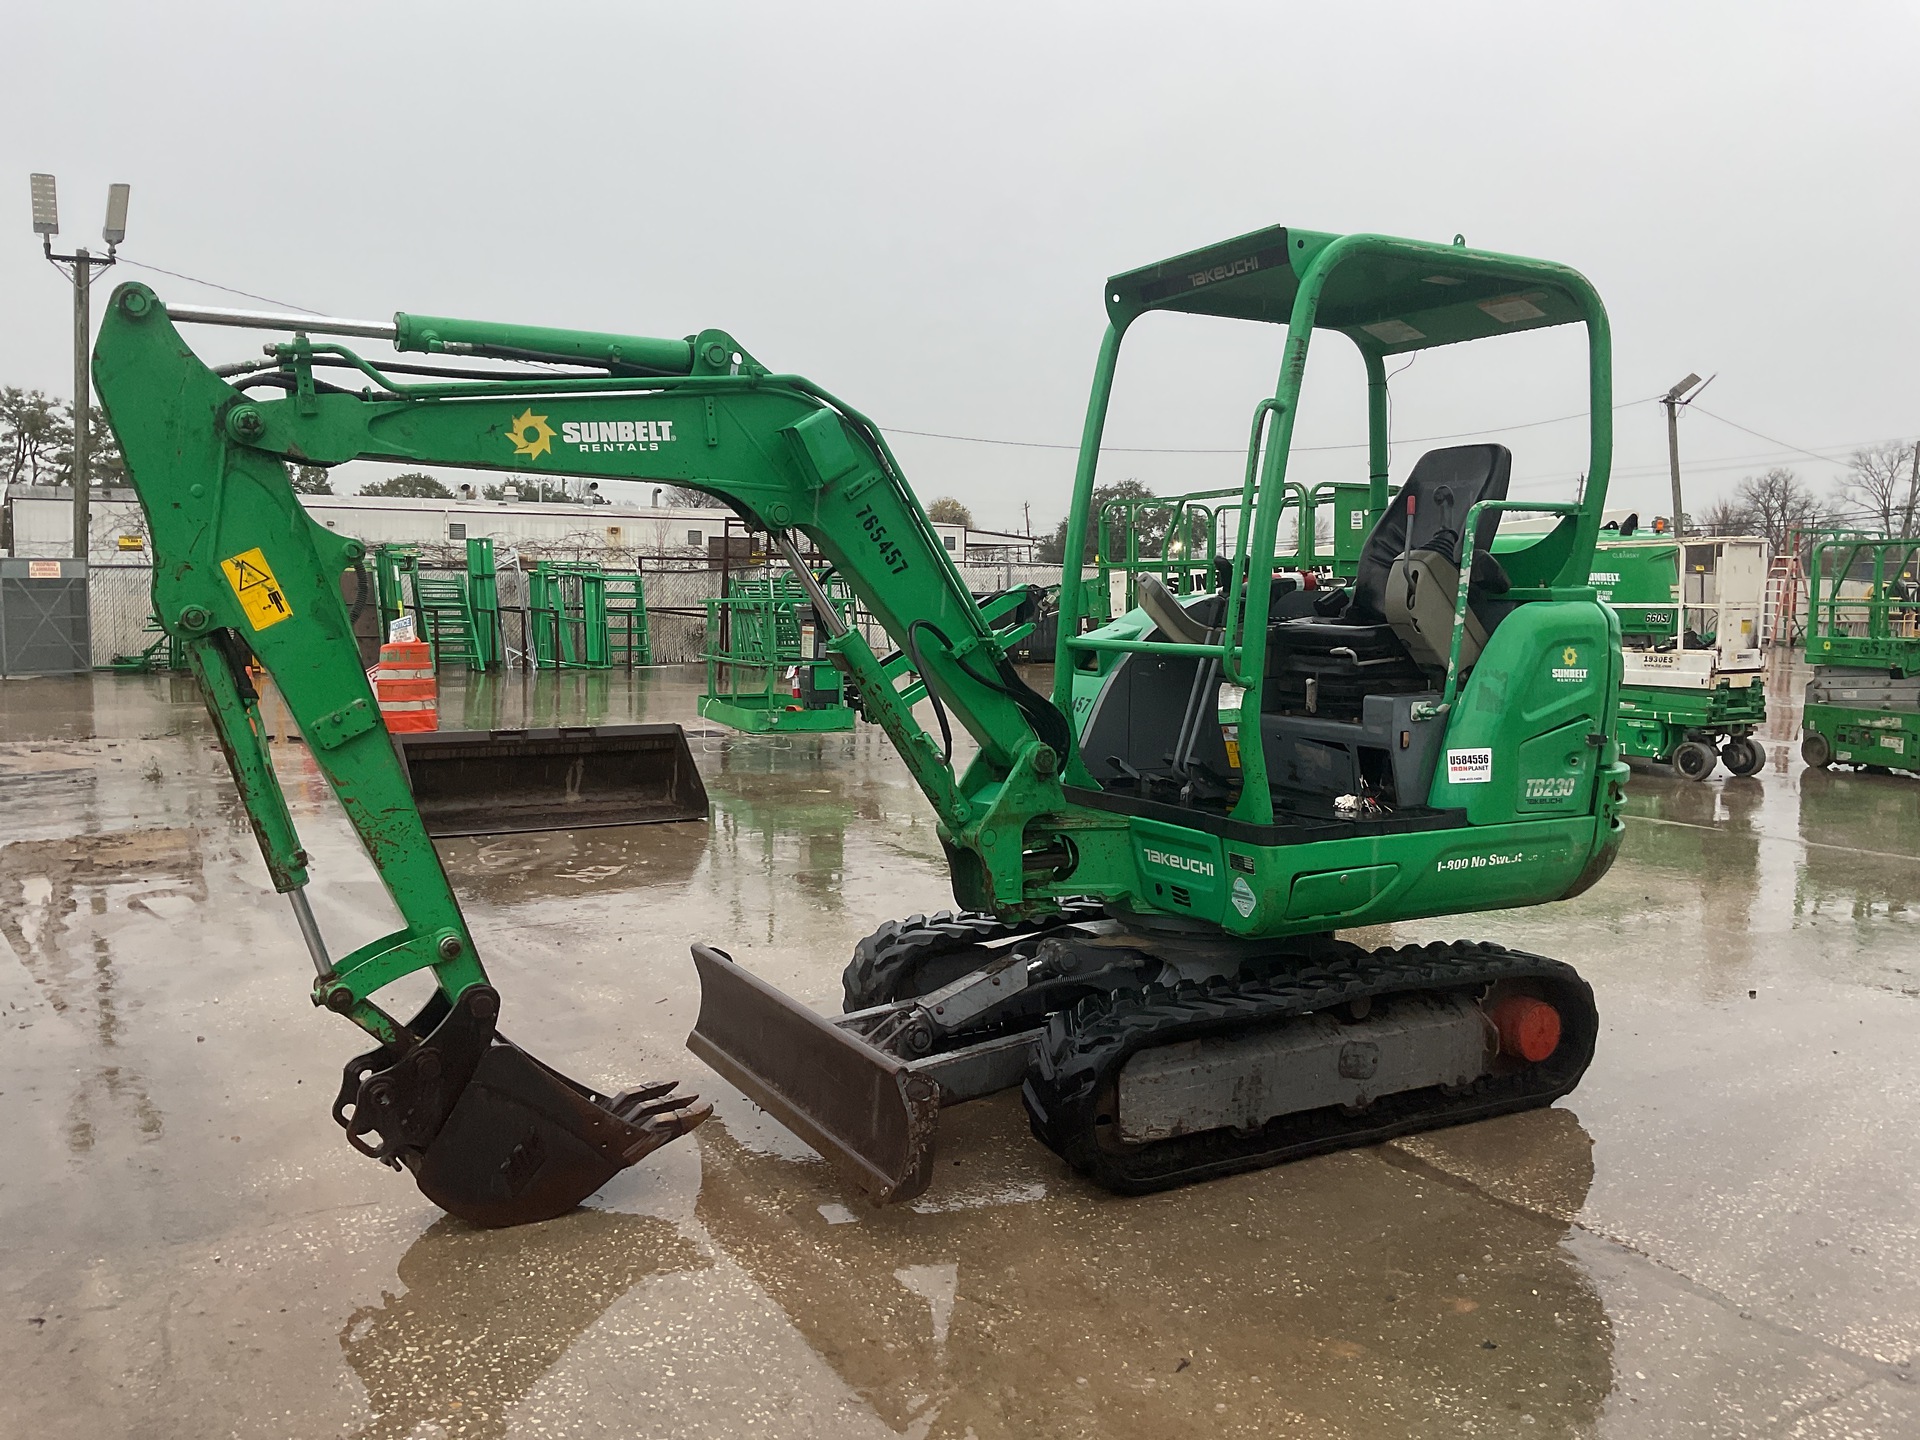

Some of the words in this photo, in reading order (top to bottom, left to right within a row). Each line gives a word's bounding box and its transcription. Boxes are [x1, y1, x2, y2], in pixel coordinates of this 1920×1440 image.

[562, 421, 673, 443] SUNBELT
[579, 443, 659, 453] RENTALS
[855, 503, 909, 575] 765457
[1588, 573, 1620, 582] UNBELT
[391, 617, 411, 631] NOTICE
[1644, 612, 1673, 624] 660SJ
[1643, 655, 1674, 664] 1930ES
[1551, 668, 1588, 679] SUNBELT
[1449, 754, 1489, 766] U584556
[1525, 777, 1575, 798] TB230
[1143, 848, 1214, 877] TAKEUCHI
[1470, 855, 1487, 868] No
